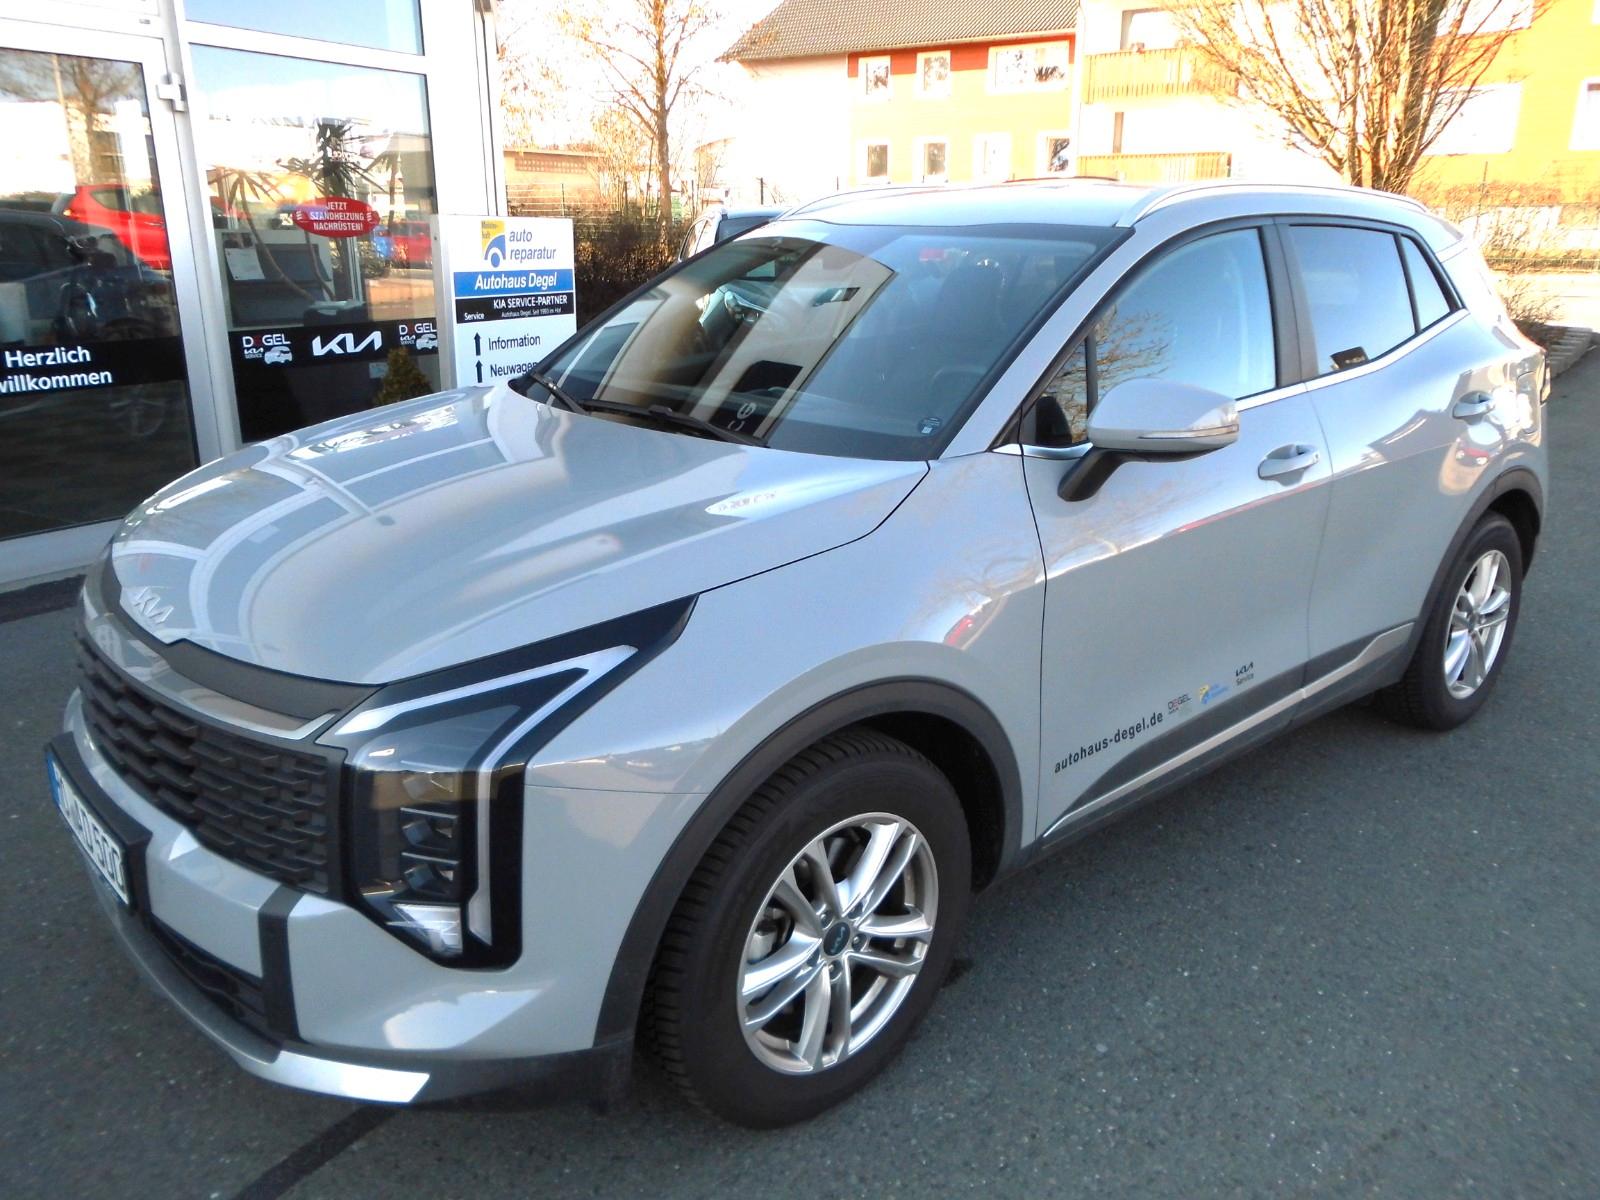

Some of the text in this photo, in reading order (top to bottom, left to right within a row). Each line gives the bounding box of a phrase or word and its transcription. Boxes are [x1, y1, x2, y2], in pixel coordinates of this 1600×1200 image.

[325, 202, 347, 210] JETZT
[309, 211, 364, 221] STANDHEIZUNG
[313, 221, 363, 231] NACHRÜSTEN!
[509, 229, 533, 242] auto
[510, 247, 557, 263] reparatur
[475, 272, 557, 291] Autohaus Degel
[493, 295, 568, 309] KIA SERVICE-PARTNER
[464, 312, 485, 321] Service
[399, 322, 438, 336] DGEL
[312, 330, 383, 356] KIA
[488, 335, 541, 351] Information
[5, 346, 91, 368] Herzlich
[244, 346, 265, 355] KIA
[1235, 661, 1254, 677] KIA
[1054, 711, 1164, 773] autohaus-degel.de
